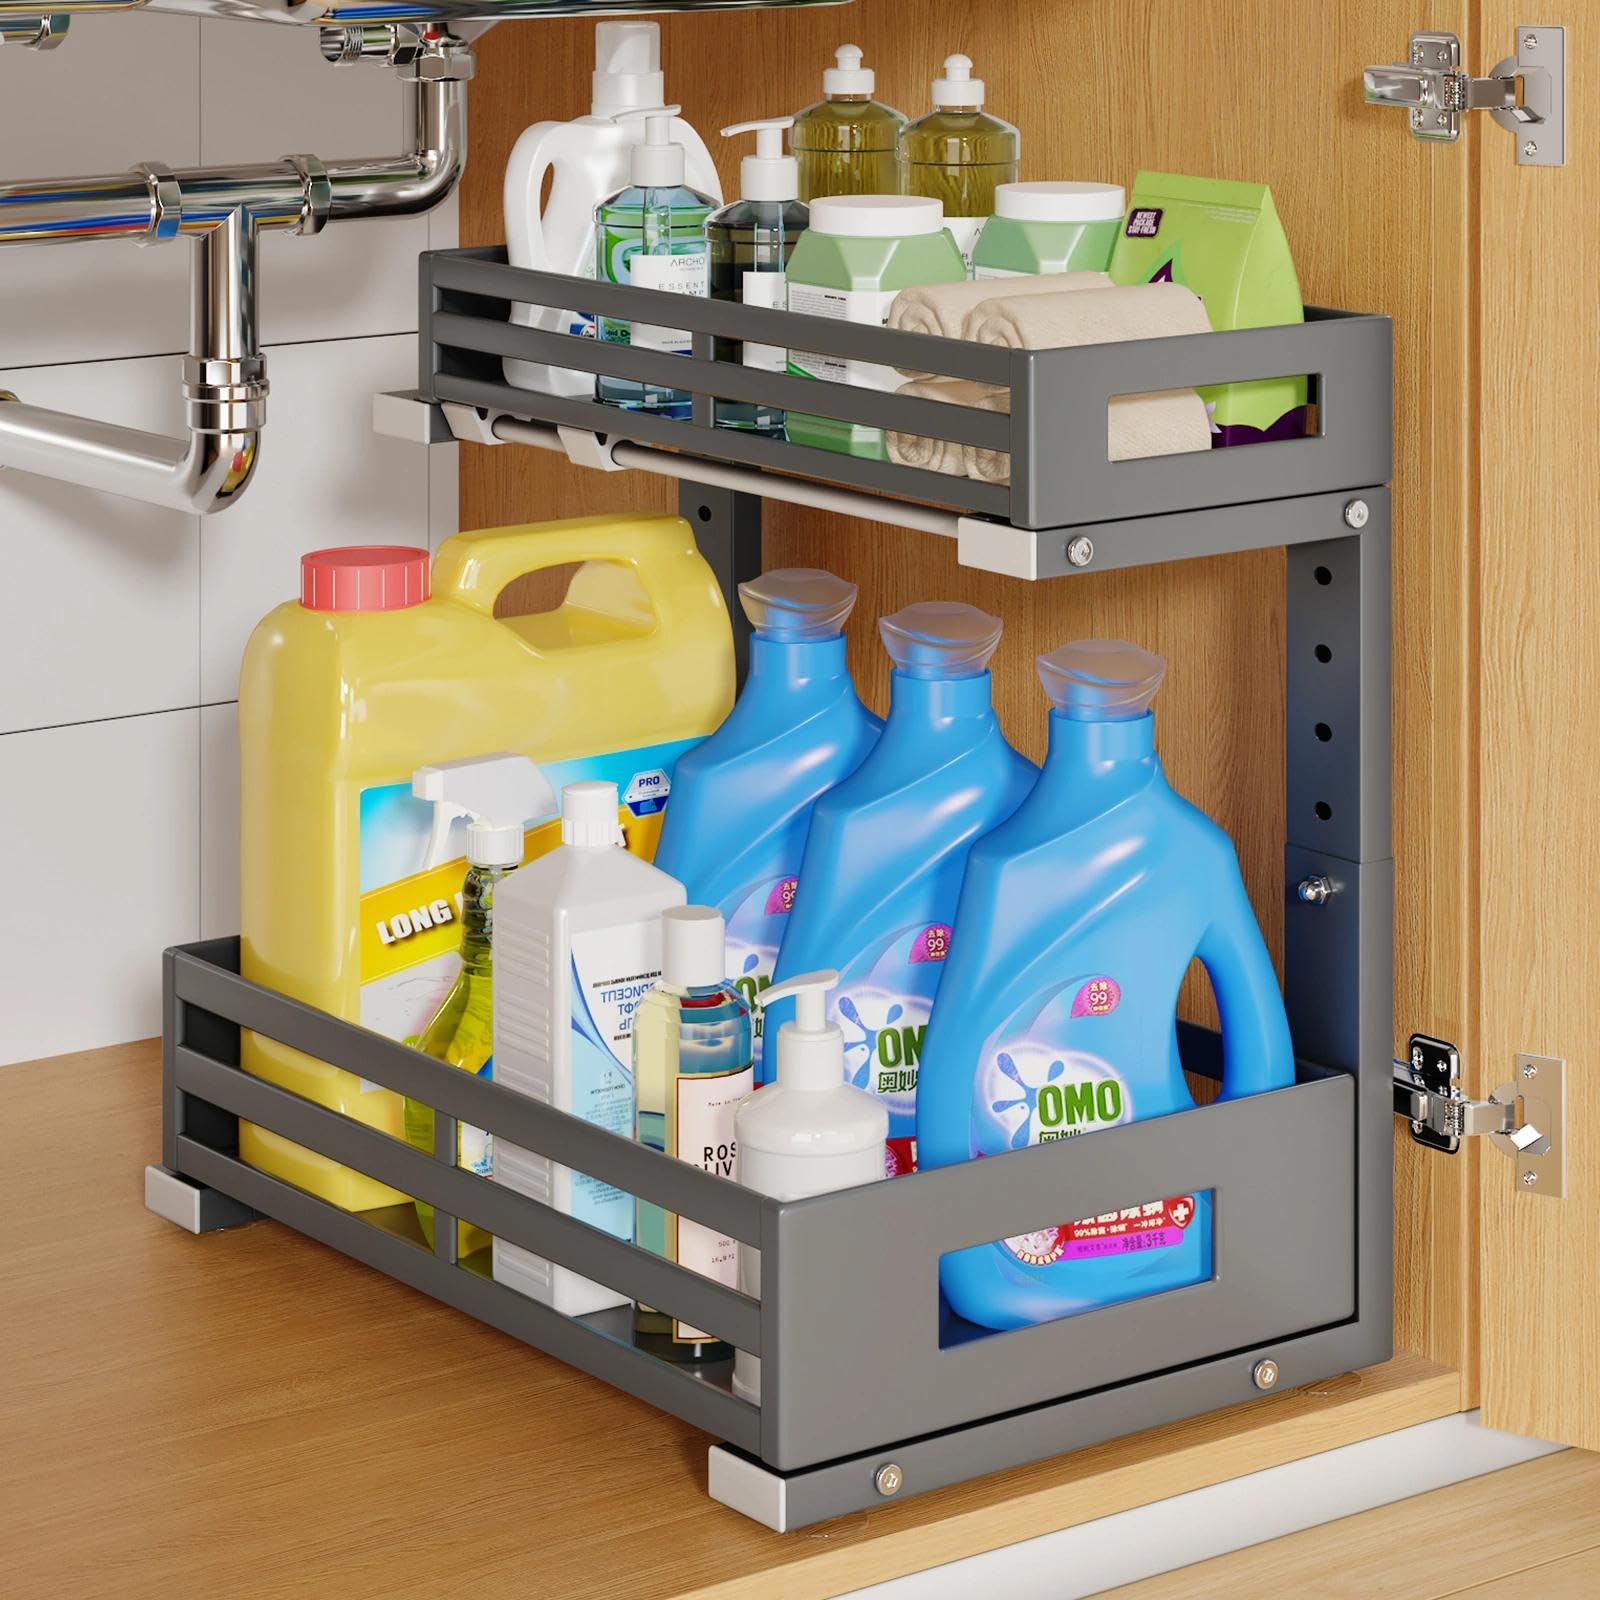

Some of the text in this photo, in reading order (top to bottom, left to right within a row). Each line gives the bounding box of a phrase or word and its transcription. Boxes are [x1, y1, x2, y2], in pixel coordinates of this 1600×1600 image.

[638, 775, 660, 787] PRO
[375, 898, 453, 945] LONG
[927, 938, 945, 952] 99
[1090, 991, 1108, 1006] 99
[1038, 1079, 1123, 1127] OMO
